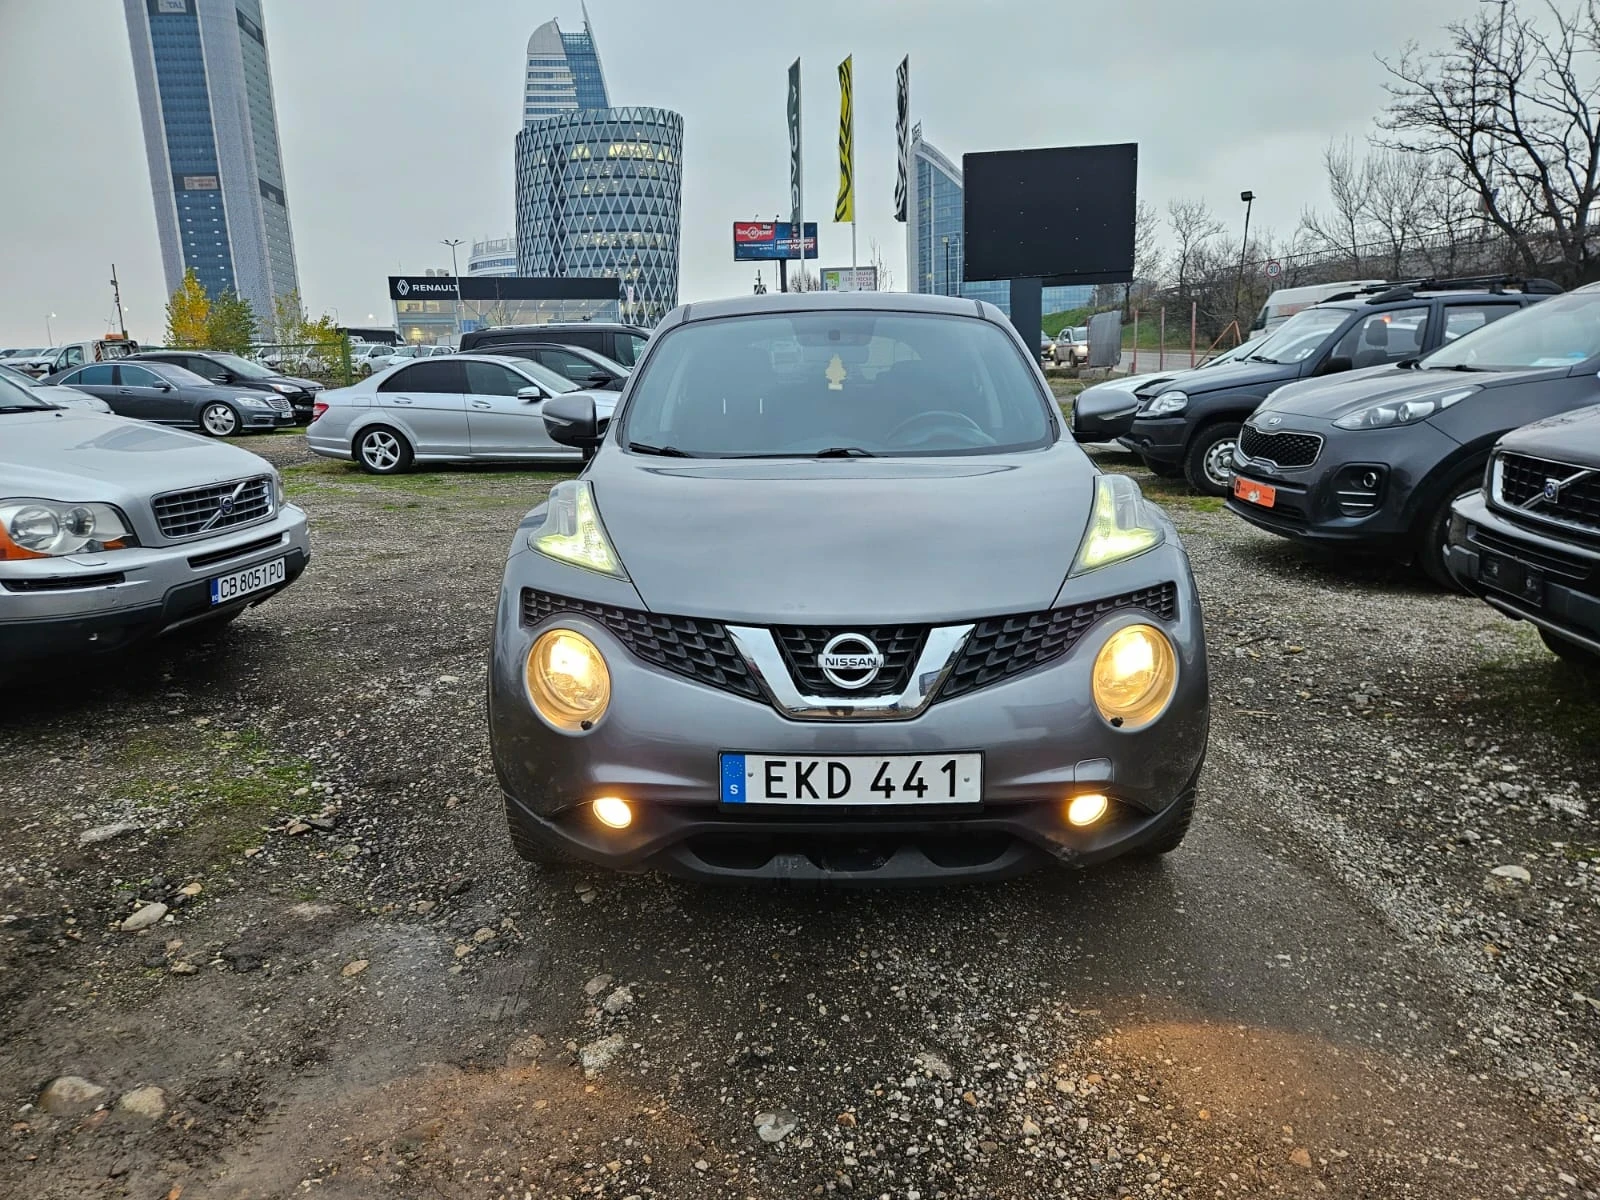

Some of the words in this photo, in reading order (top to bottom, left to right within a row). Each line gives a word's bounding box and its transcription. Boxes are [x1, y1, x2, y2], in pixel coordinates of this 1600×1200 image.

[1269, 265, 1278, 274] 30
[412, 284, 459, 292] RENAULT
[220, 576, 238, 598] CB
[240, 566, 267, 592] 8051
[825, 657, 877, 666] NISSAN
[764, 760, 852, 799] EKD
[870, 760, 956, 799] 441
[730, 784, 738, 795] S
